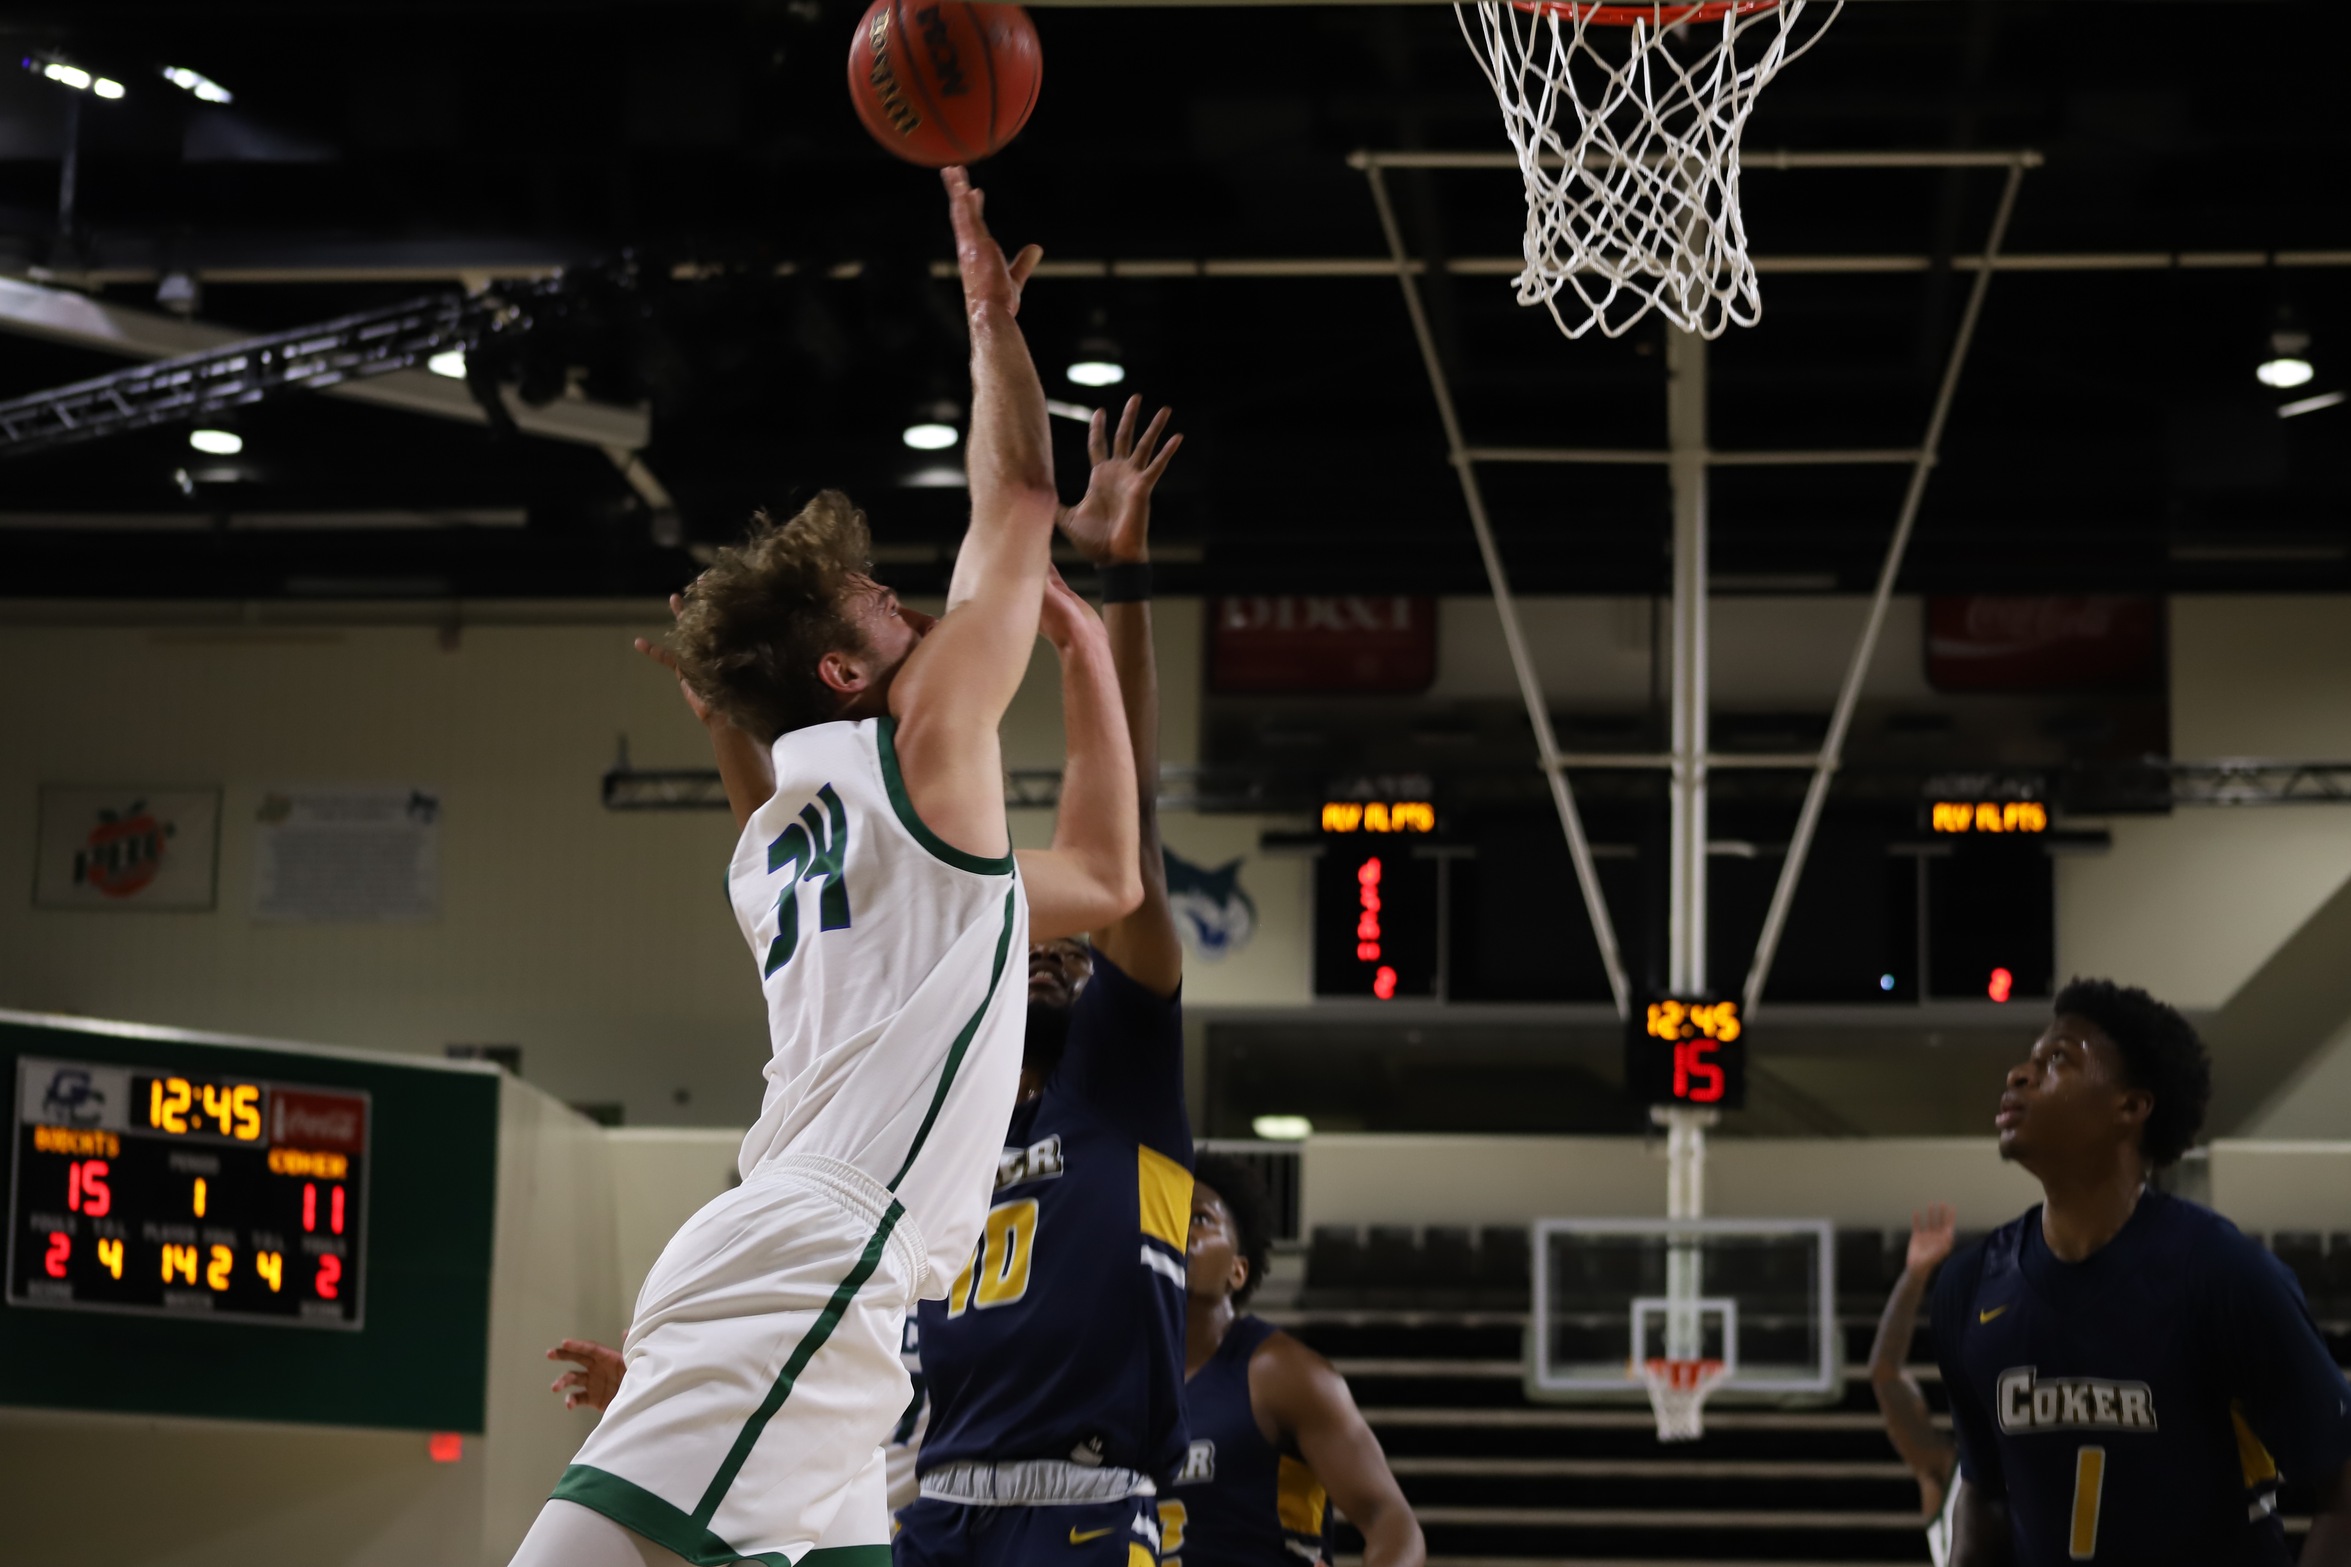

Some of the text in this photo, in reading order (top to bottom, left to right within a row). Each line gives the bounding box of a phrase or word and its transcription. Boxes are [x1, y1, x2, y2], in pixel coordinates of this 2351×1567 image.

[764, 781, 851, 981] 34
[1646, 1000, 1742, 1042] 12:45
[1673, 1038, 1726, 1103] 15
[150, 1077, 262, 1141] 12:45
[67, 1159, 112, 1218] 15
[193, 1176, 207, 1219] 1
[302, 1181, 346, 1236] 11
[44, 1231, 72, 1279] 2
[97, 1237, 125, 1281] 4
[160, 1242, 198, 1286] 14
[206, 1243, 234, 1292] 2
[256, 1250, 282, 1294] 4
[315, 1253, 343, 1300] 2
[1997, 1365, 2158, 1435] COKER
[2069, 1444, 2106, 1561] 1
